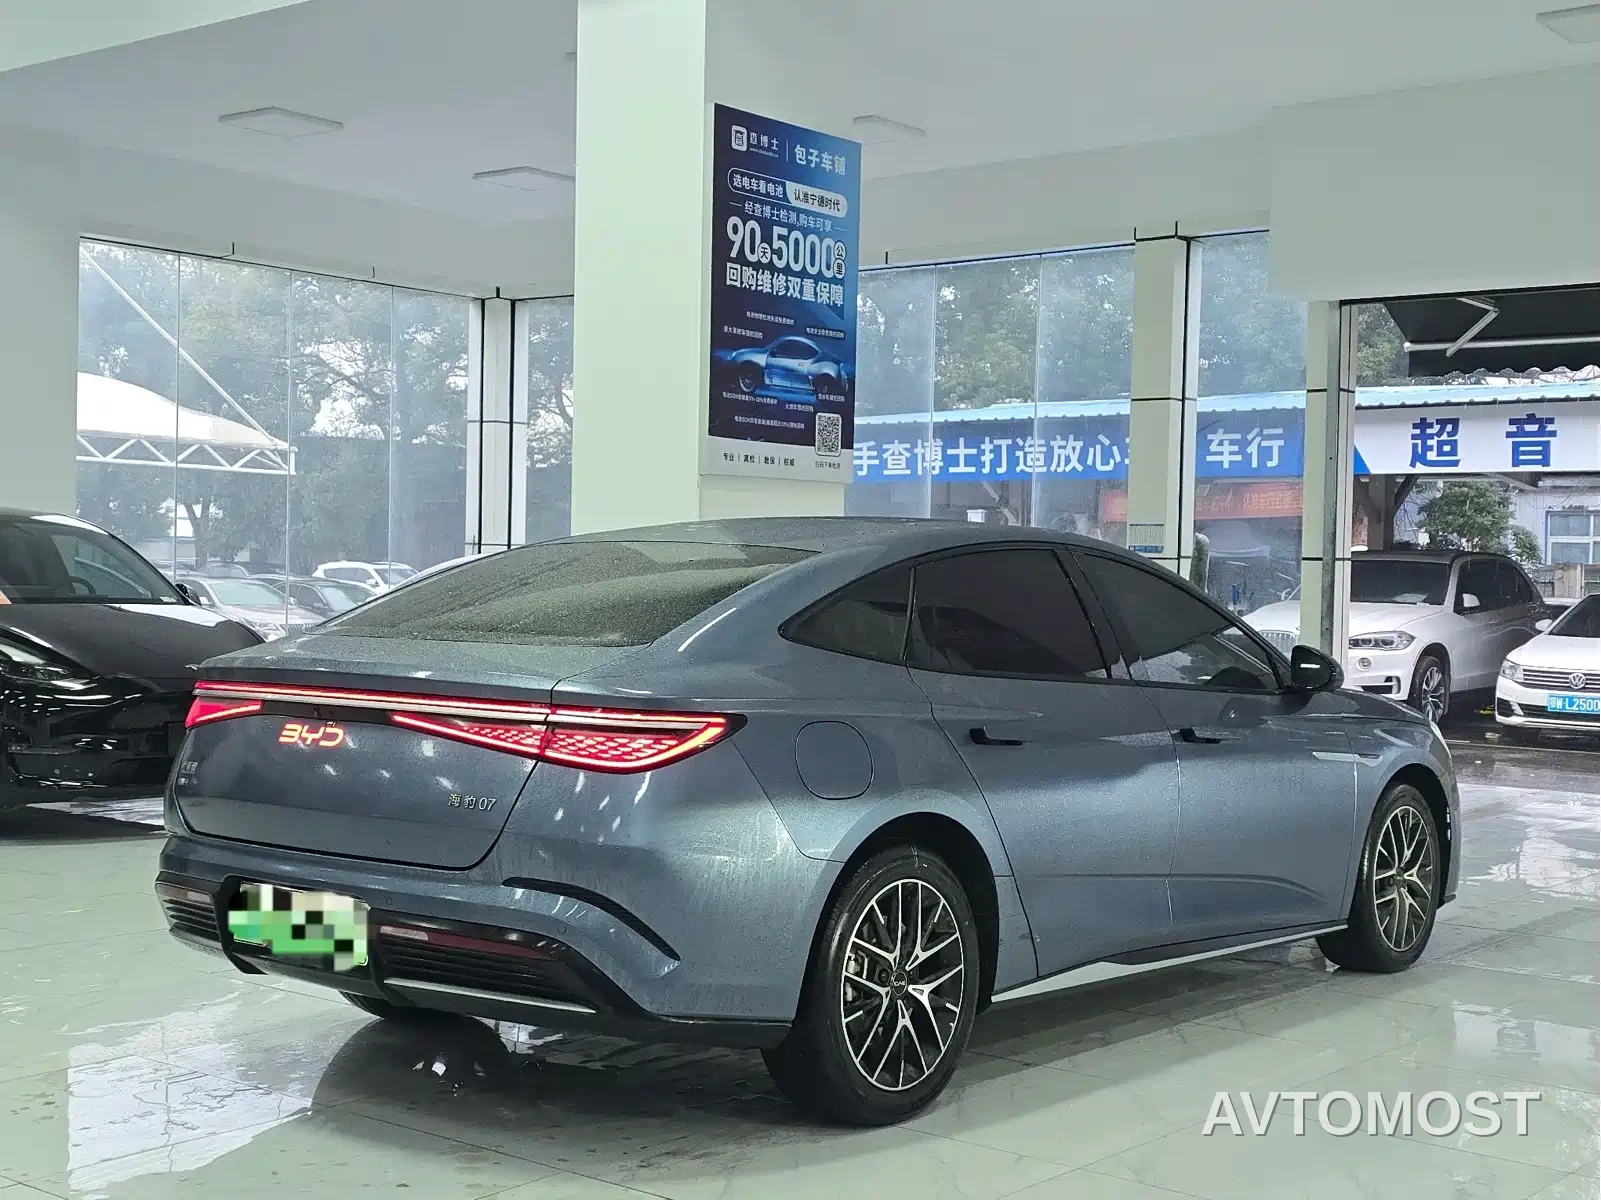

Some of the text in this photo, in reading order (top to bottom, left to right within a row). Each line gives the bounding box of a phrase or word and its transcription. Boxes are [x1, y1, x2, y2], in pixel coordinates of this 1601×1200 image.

[794, 144, 846, 175] 包子车铺
[732, 173, 783, 198] 选电车看电池
[794, 188, 840, 211] 认准宁德时代
[725, 261, 844, 307] 回购维修双重保障
[723, 452, 735, 462] 专业
[1206, 427, 1285, 468] 车行
[279, 723, 344, 747] BYD
